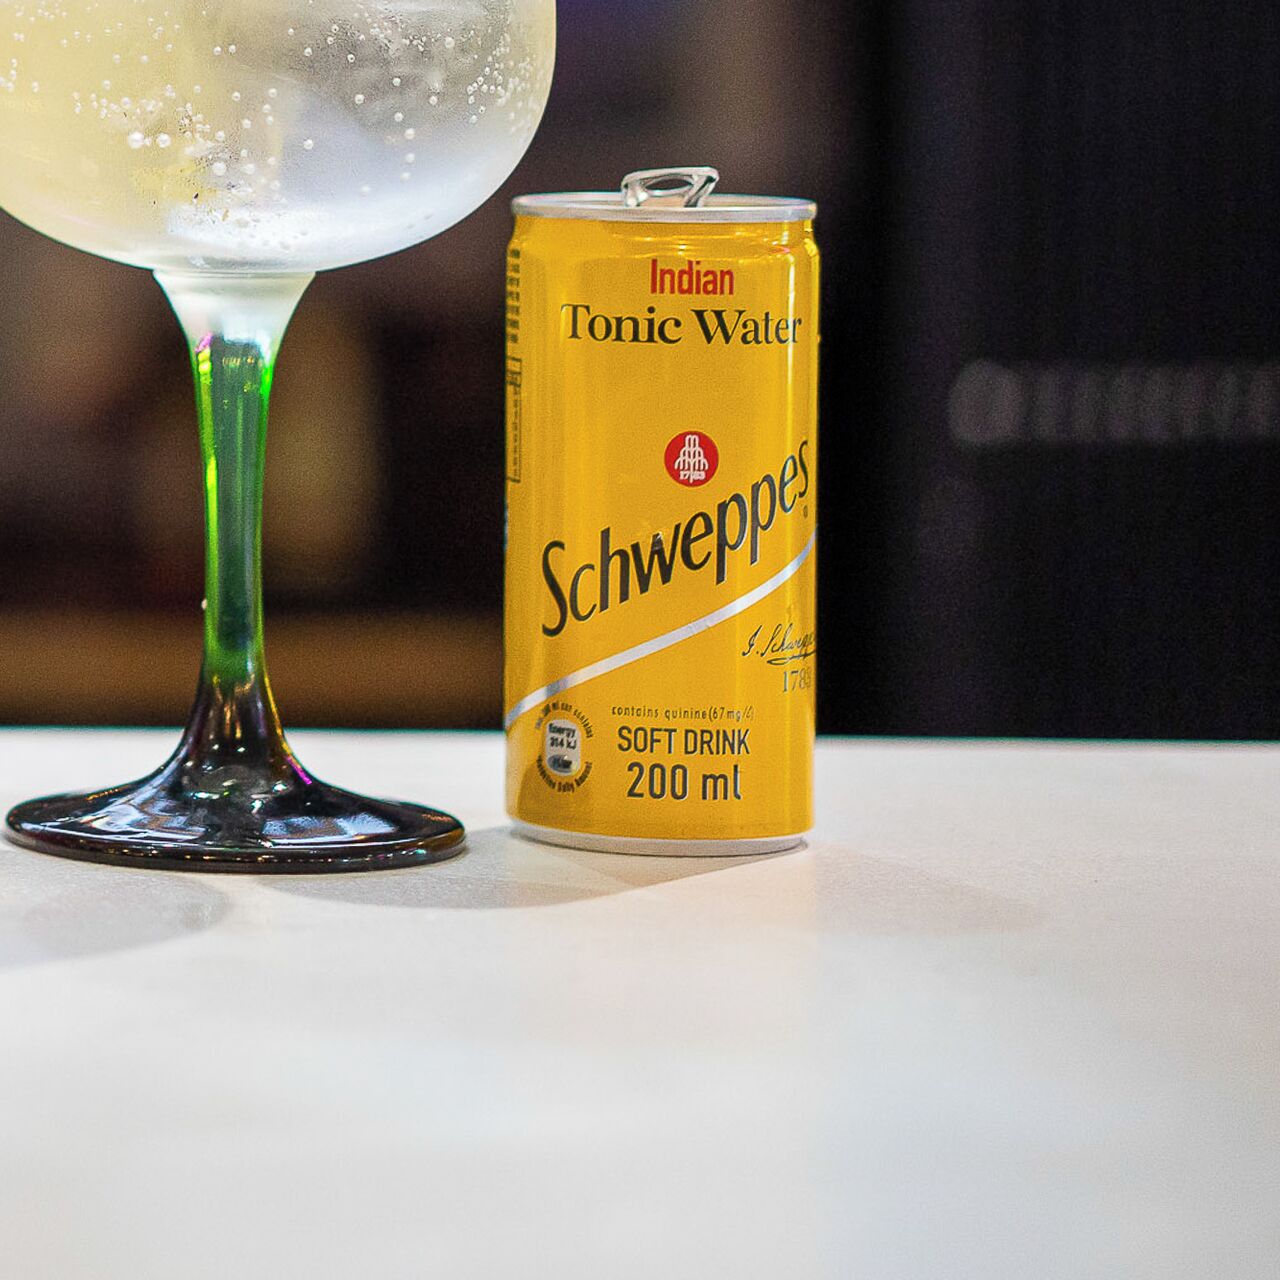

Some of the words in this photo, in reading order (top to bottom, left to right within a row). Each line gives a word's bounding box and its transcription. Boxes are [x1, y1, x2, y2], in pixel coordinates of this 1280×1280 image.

[650, 259, 734, 295] Indian
[561, 304, 682, 344] Tonic
[690, 309, 802, 345] Water
[541, 440, 808, 638] Schweppes
[611, 706, 659, 718] contains
[549, 723, 576, 738] Energy
[617, 725, 677, 754] SOFT
[684, 728, 750, 755] DRINK
[626, 761, 688, 800] 200
[701, 764, 742, 800] ml
